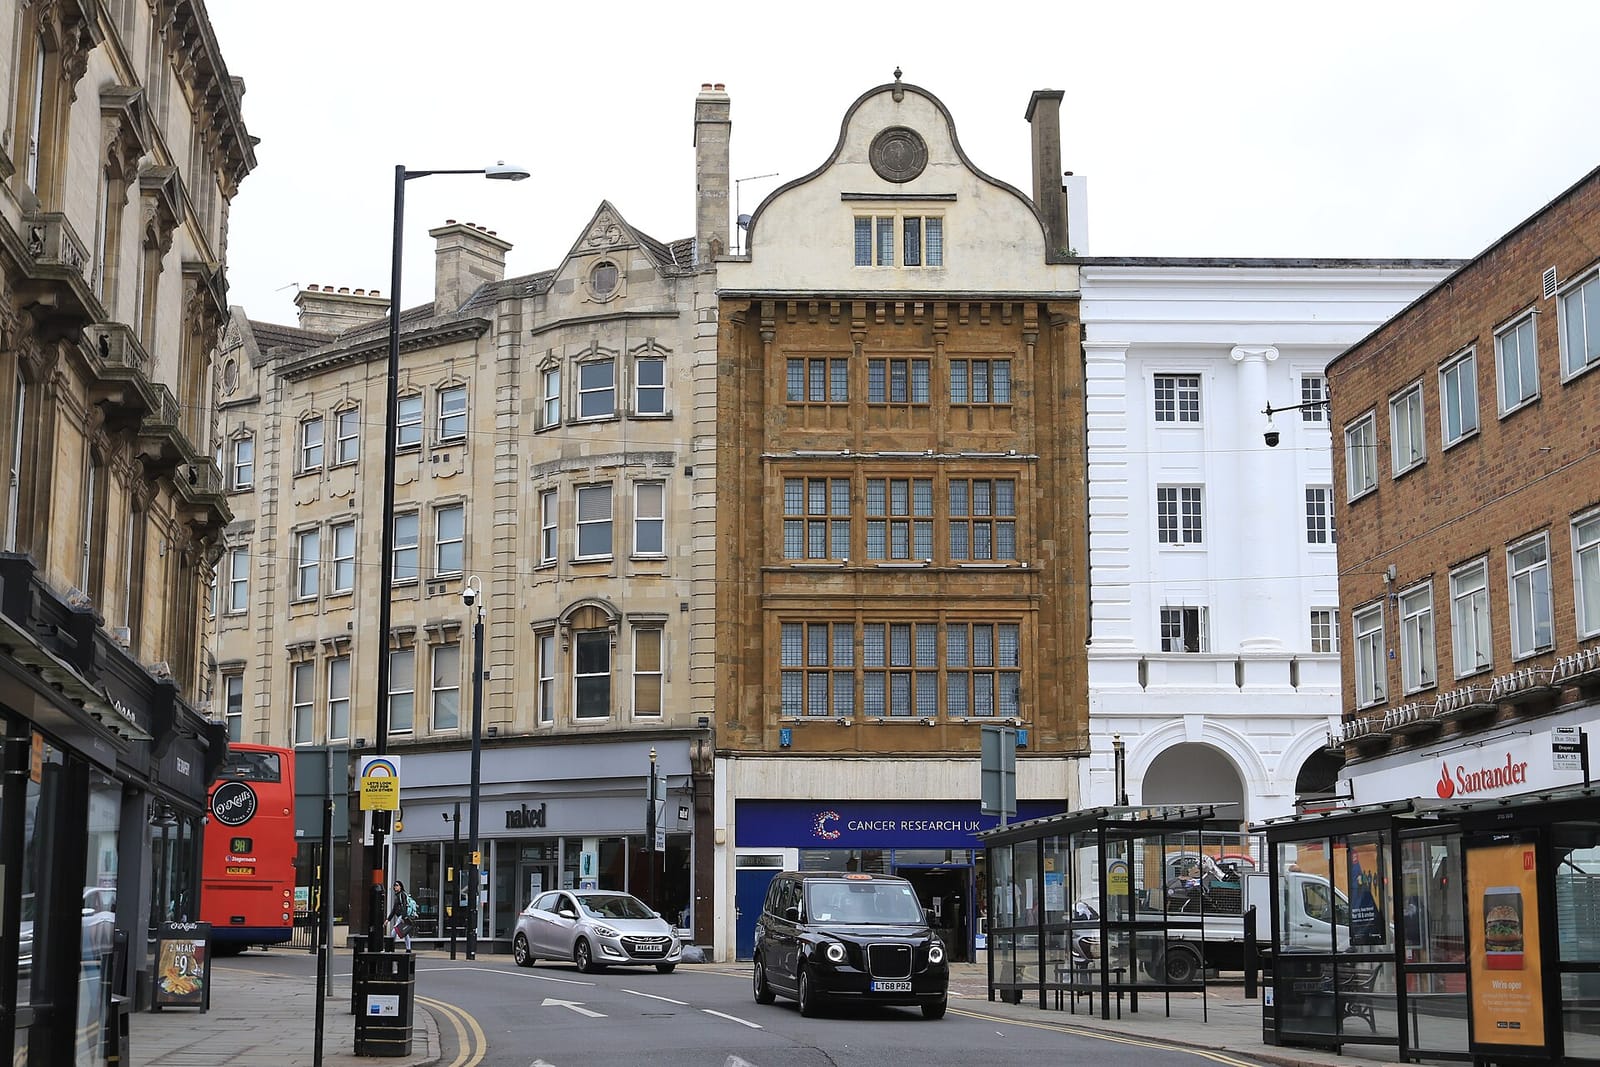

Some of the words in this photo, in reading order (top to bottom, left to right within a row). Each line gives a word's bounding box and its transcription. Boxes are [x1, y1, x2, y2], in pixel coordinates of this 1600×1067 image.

[1456, 752, 1528, 795] Santander
[216, 791, 251, 815] O'Neill's
[505, 803, 546, 828] naked
[847, 820, 896, 831] CANCER
[901, 820, 961, 831] RESEARCH
[964, 820, 980, 831] UK
[176, 943, 196, 953] MEALS
